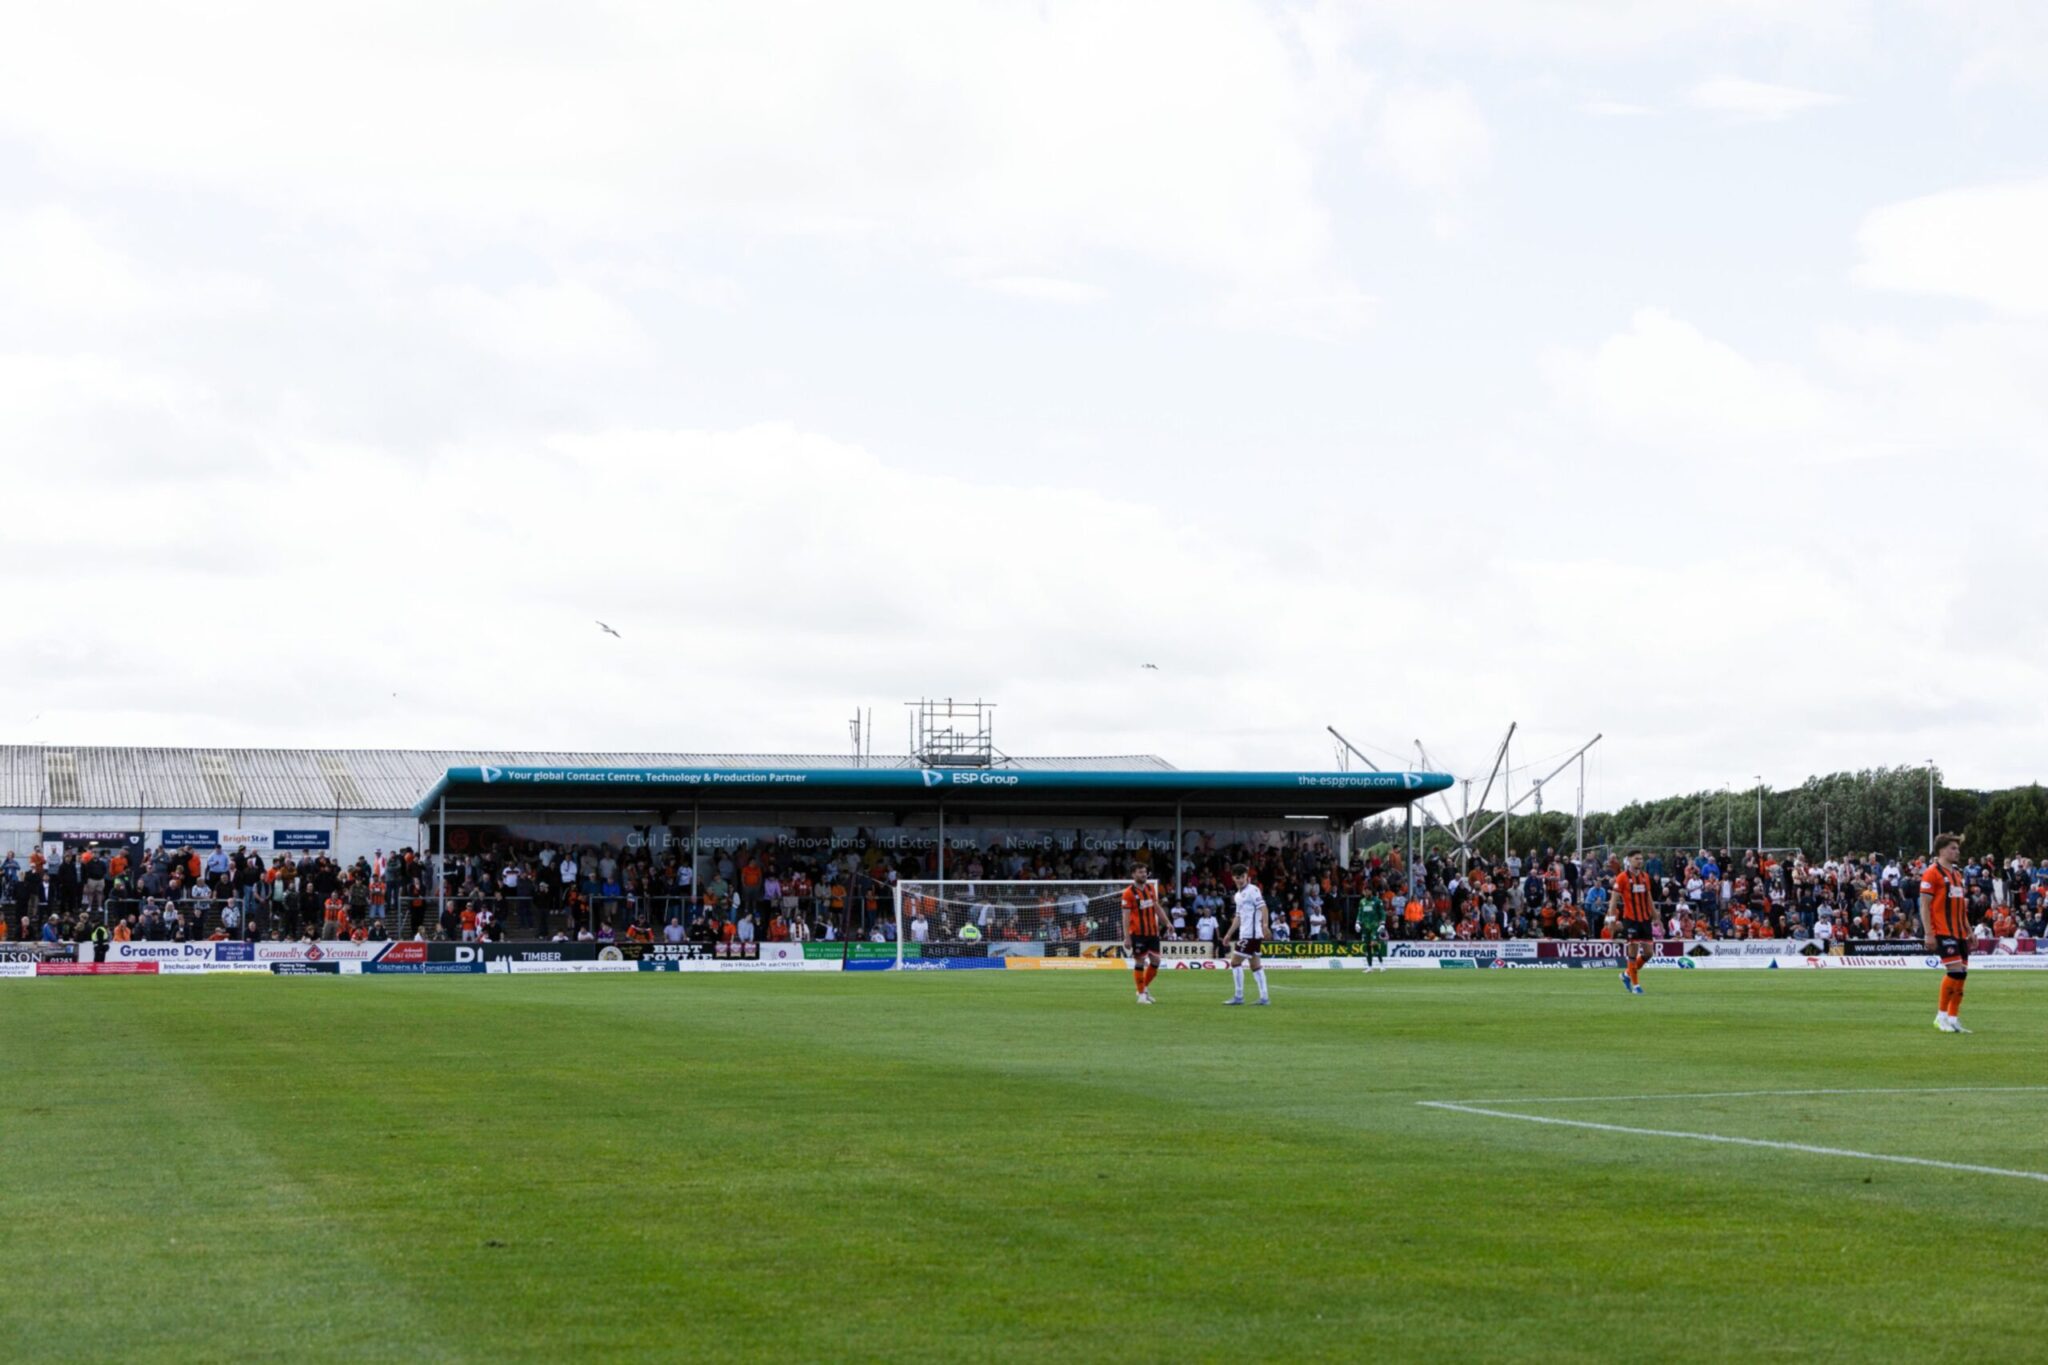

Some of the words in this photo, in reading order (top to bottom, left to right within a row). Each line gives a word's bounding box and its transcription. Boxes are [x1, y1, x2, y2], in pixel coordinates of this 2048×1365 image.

[508, 771, 532, 780] Your
[534, 771, 564, 782] global
[567, 772, 605, 781] Contact
[608, 772, 644, 782] Centre,
[646, 773, 701, 784] Technology
[703, 773, 711, 782] &
[713, 773, 767, 782] Production
[770, 774, 807, 783] Partner
[952, 773, 977, 784] ESP
[980, 773, 1018, 786] Group
[1298, 776, 1397, 788] the-espgroup.com
[626, 833, 657, 847] Civil
[778, 834, 867, 849] Renovations
[120, 945, 179, 957] Graeme
[184, 945, 213, 960] Dey
[259, 947, 303, 959] Connelly
[325, 948, 369, 958] Yeoman
[653, 945, 703, 953] BERT
[1162, 946, 1206, 955] RRIERS
[1260, 943, 1292, 955] MES
[1295, 943, 1334, 955] GIBB
[1336, 943, 1348, 955] &
[1399, 949, 1426, 958] KIDD
[1428, 949, 1457, 958] AUTO
[1459, 949, 1498, 958] REPAIR
[521, 952, 562, 961] TIMBER
[643, 953, 713, 961] FOWLIE
[1175, 961, 1216, 969] ADG
[1507, 961, 1569, 969] Domino's
[1839, 957, 1907, 966] Hillwood
[164, 963, 202, 971] Inchcape
